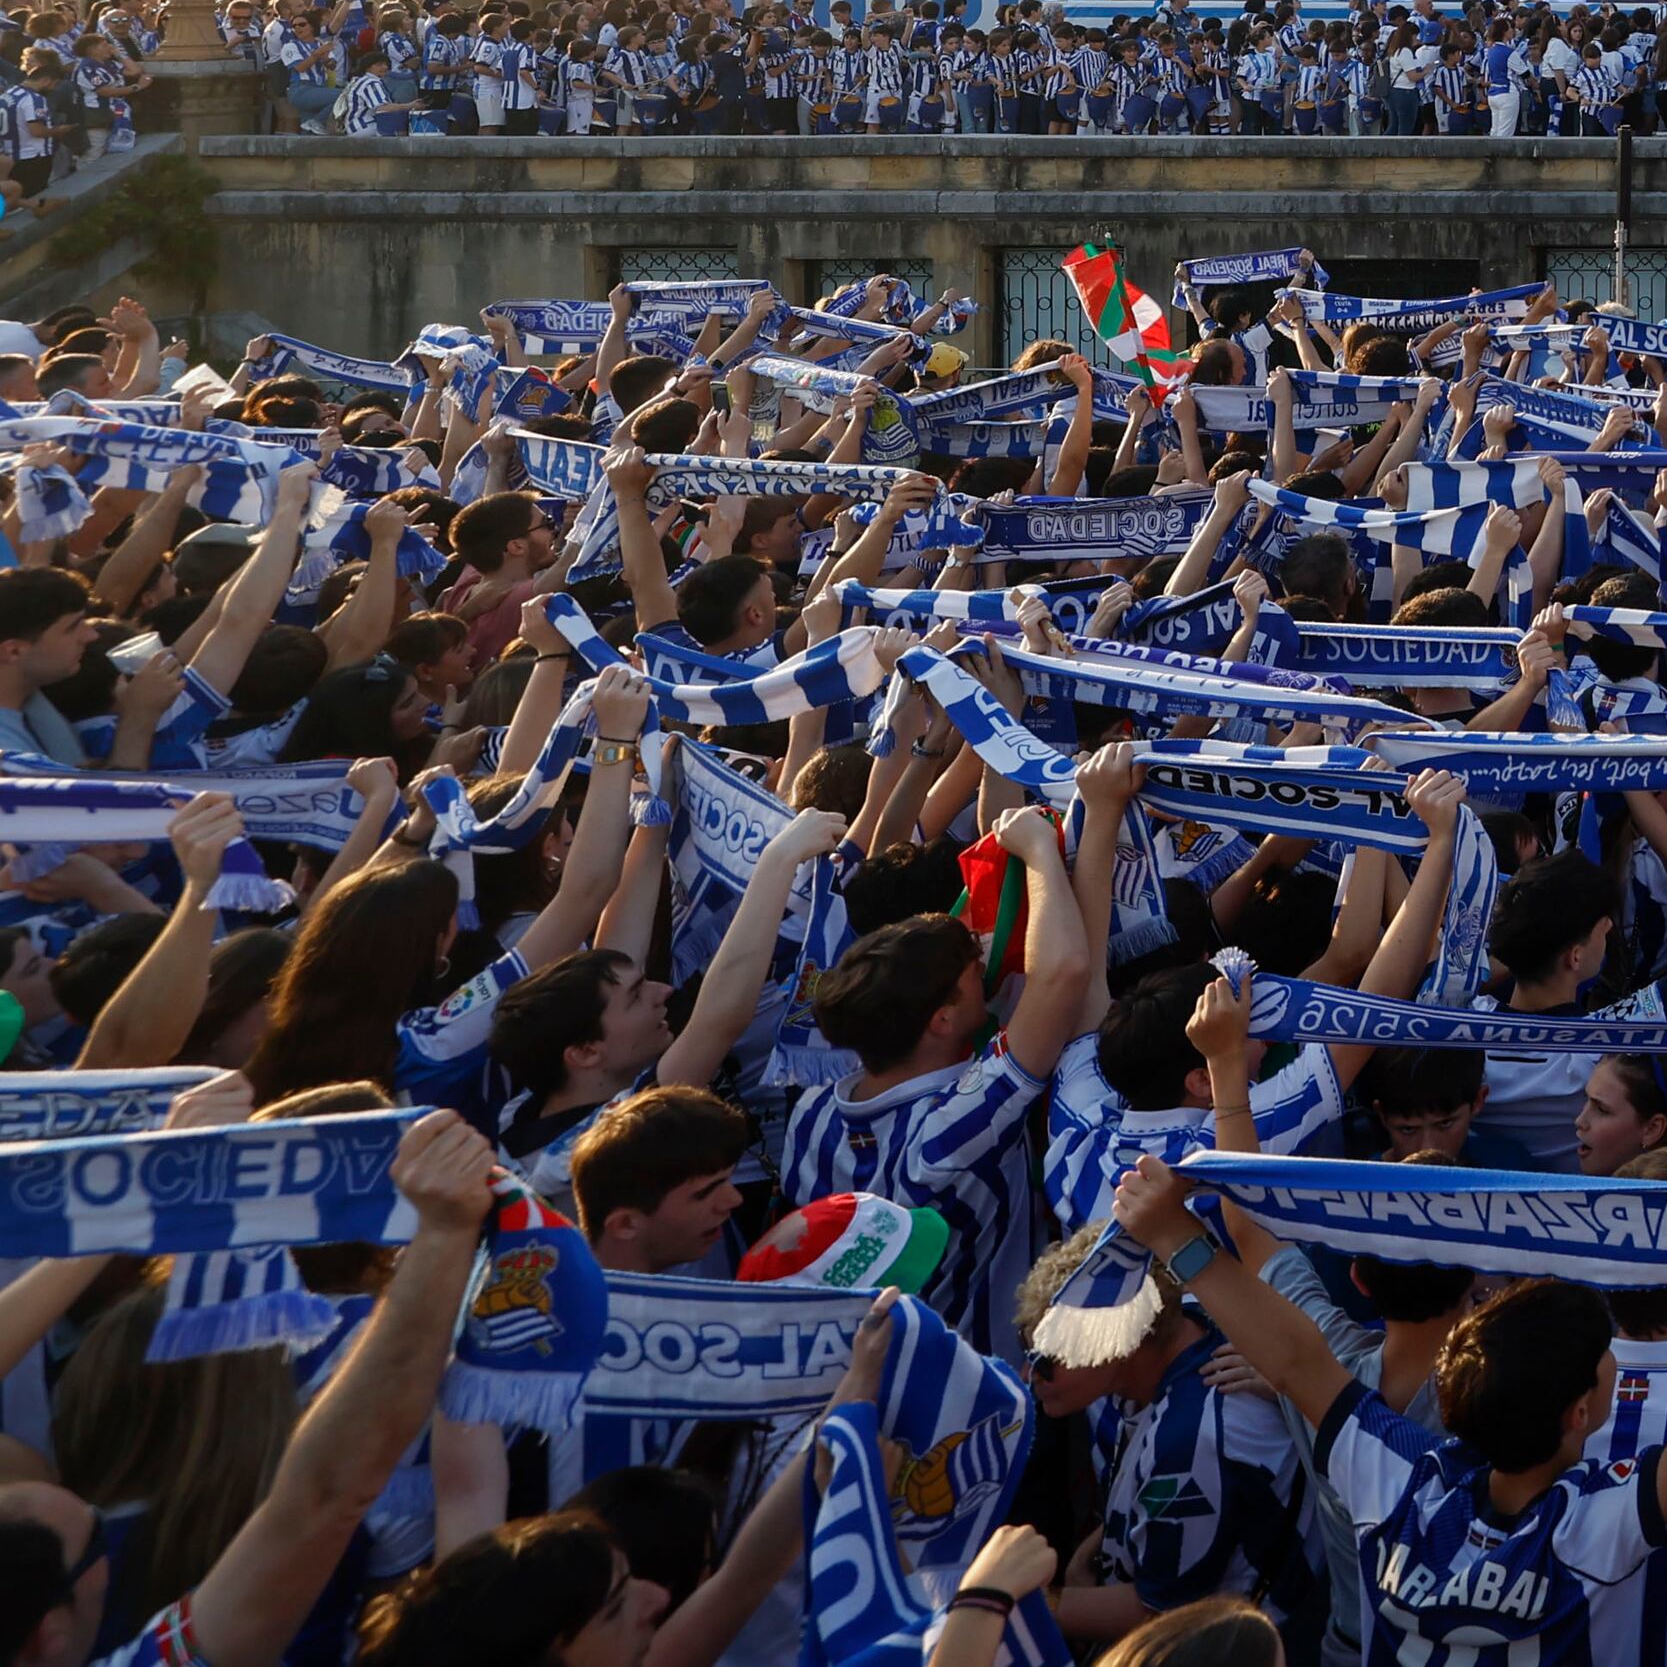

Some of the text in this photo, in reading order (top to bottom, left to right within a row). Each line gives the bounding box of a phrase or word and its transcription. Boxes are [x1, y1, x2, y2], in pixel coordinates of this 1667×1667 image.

[1596, 315, 1641, 346] EAL
[1327, 637, 1491, 665] SOCIEDAD
[1146, 763, 1342, 809] SOCIED
